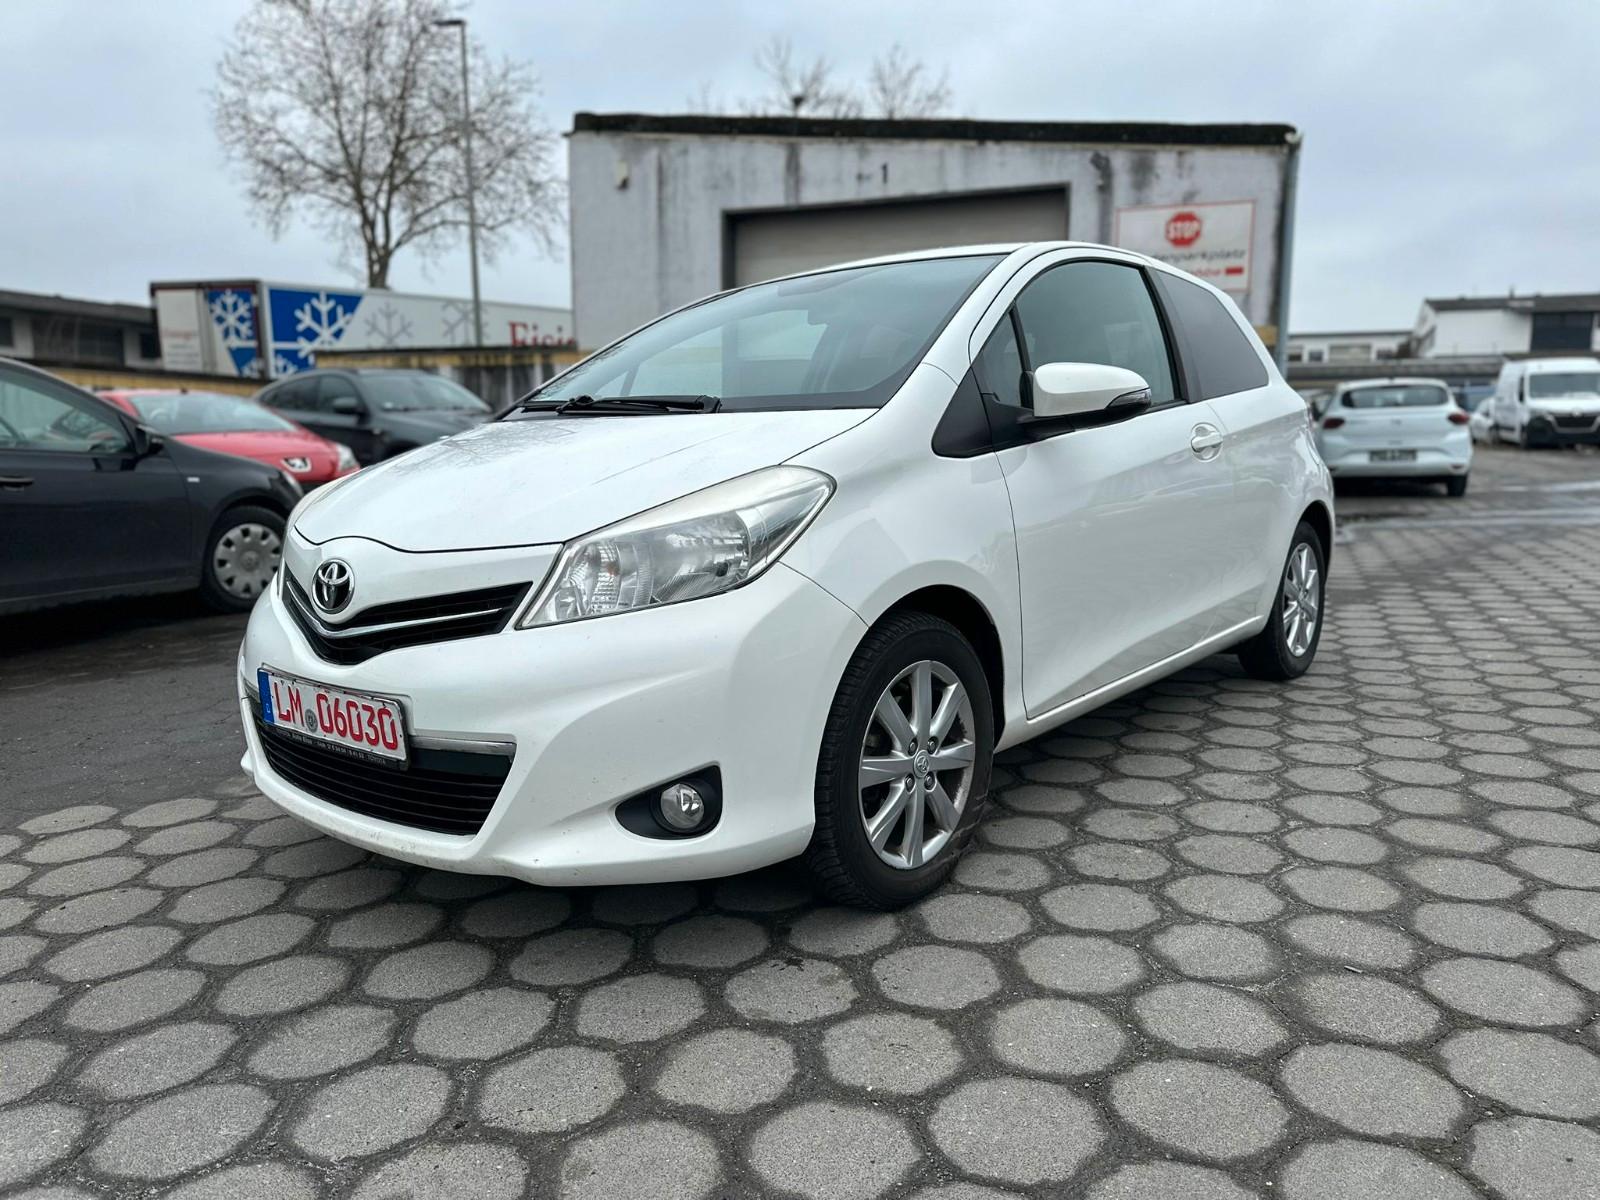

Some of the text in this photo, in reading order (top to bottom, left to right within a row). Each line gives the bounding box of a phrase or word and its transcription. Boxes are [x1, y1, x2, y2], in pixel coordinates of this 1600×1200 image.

[1167, 220, 1201, 240] STOP
[273, 682, 304, 728] LM
[316, 692, 398, 751] 06030
